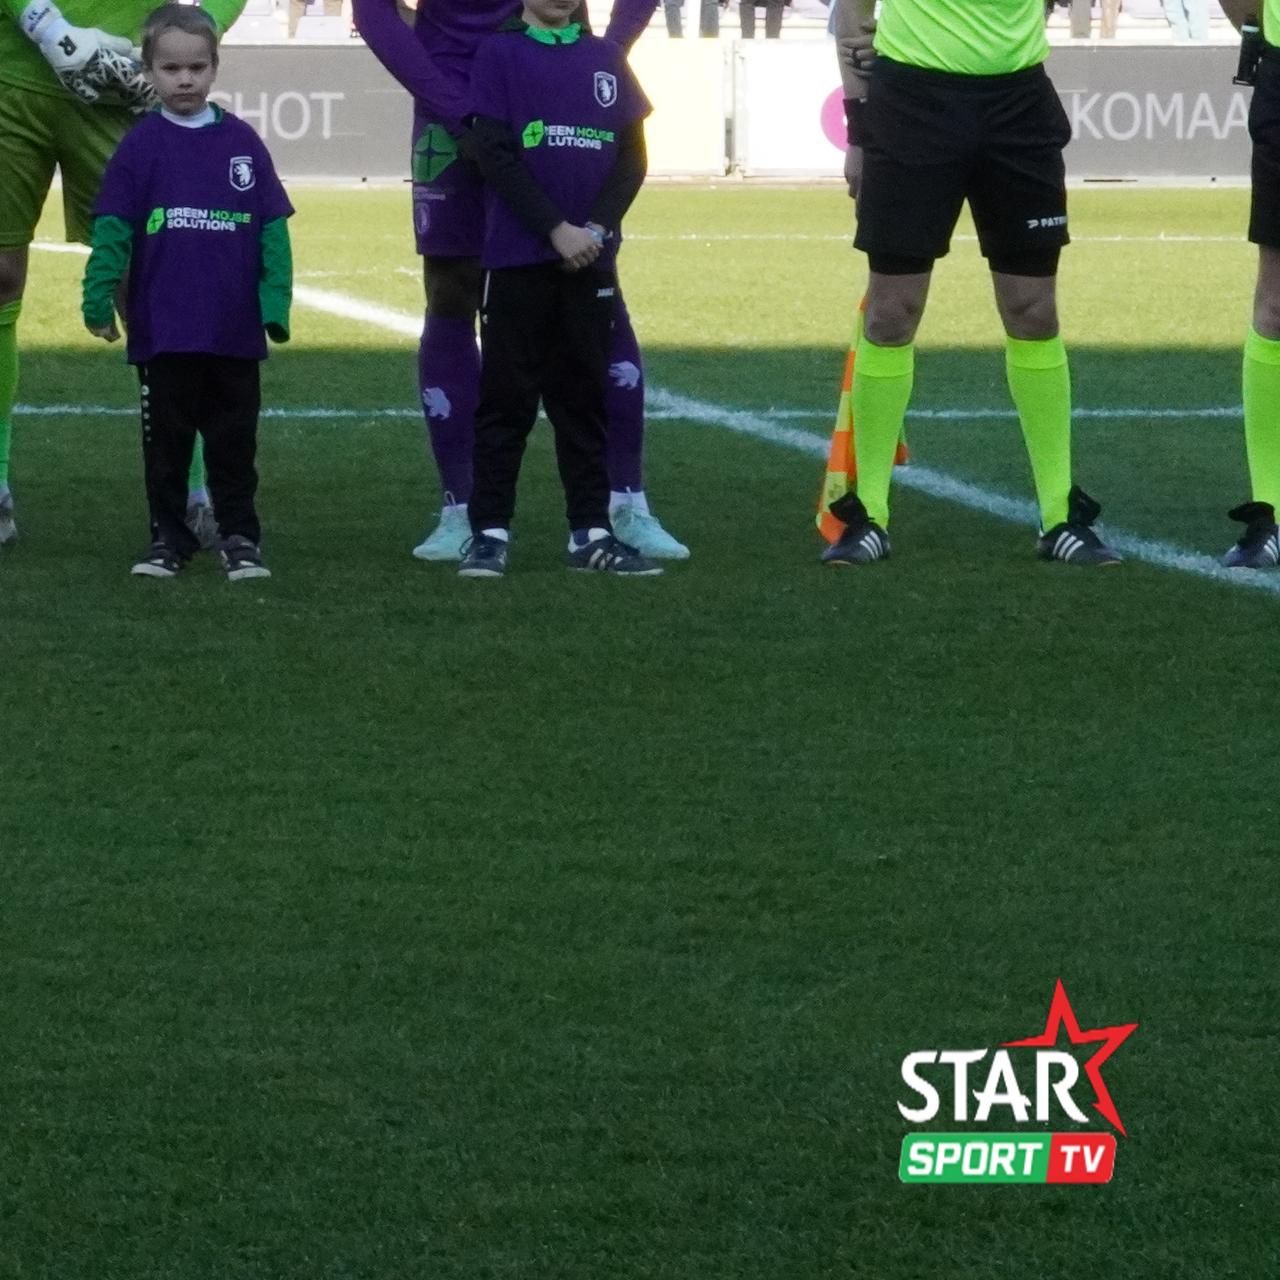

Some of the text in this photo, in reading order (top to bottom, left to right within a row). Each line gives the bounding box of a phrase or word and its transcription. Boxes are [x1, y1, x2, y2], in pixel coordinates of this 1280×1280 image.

[1070, 91, 1251, 141] KOMAA
[576, 126, 615, 142] HOUSE
[548, 136, 602, 150] LUTIONS
[166, 207, 208, 219] GREEN
[167, 218, 236, 231] SOLUTIONS
[1041, 215, 1067, 227] PATR
